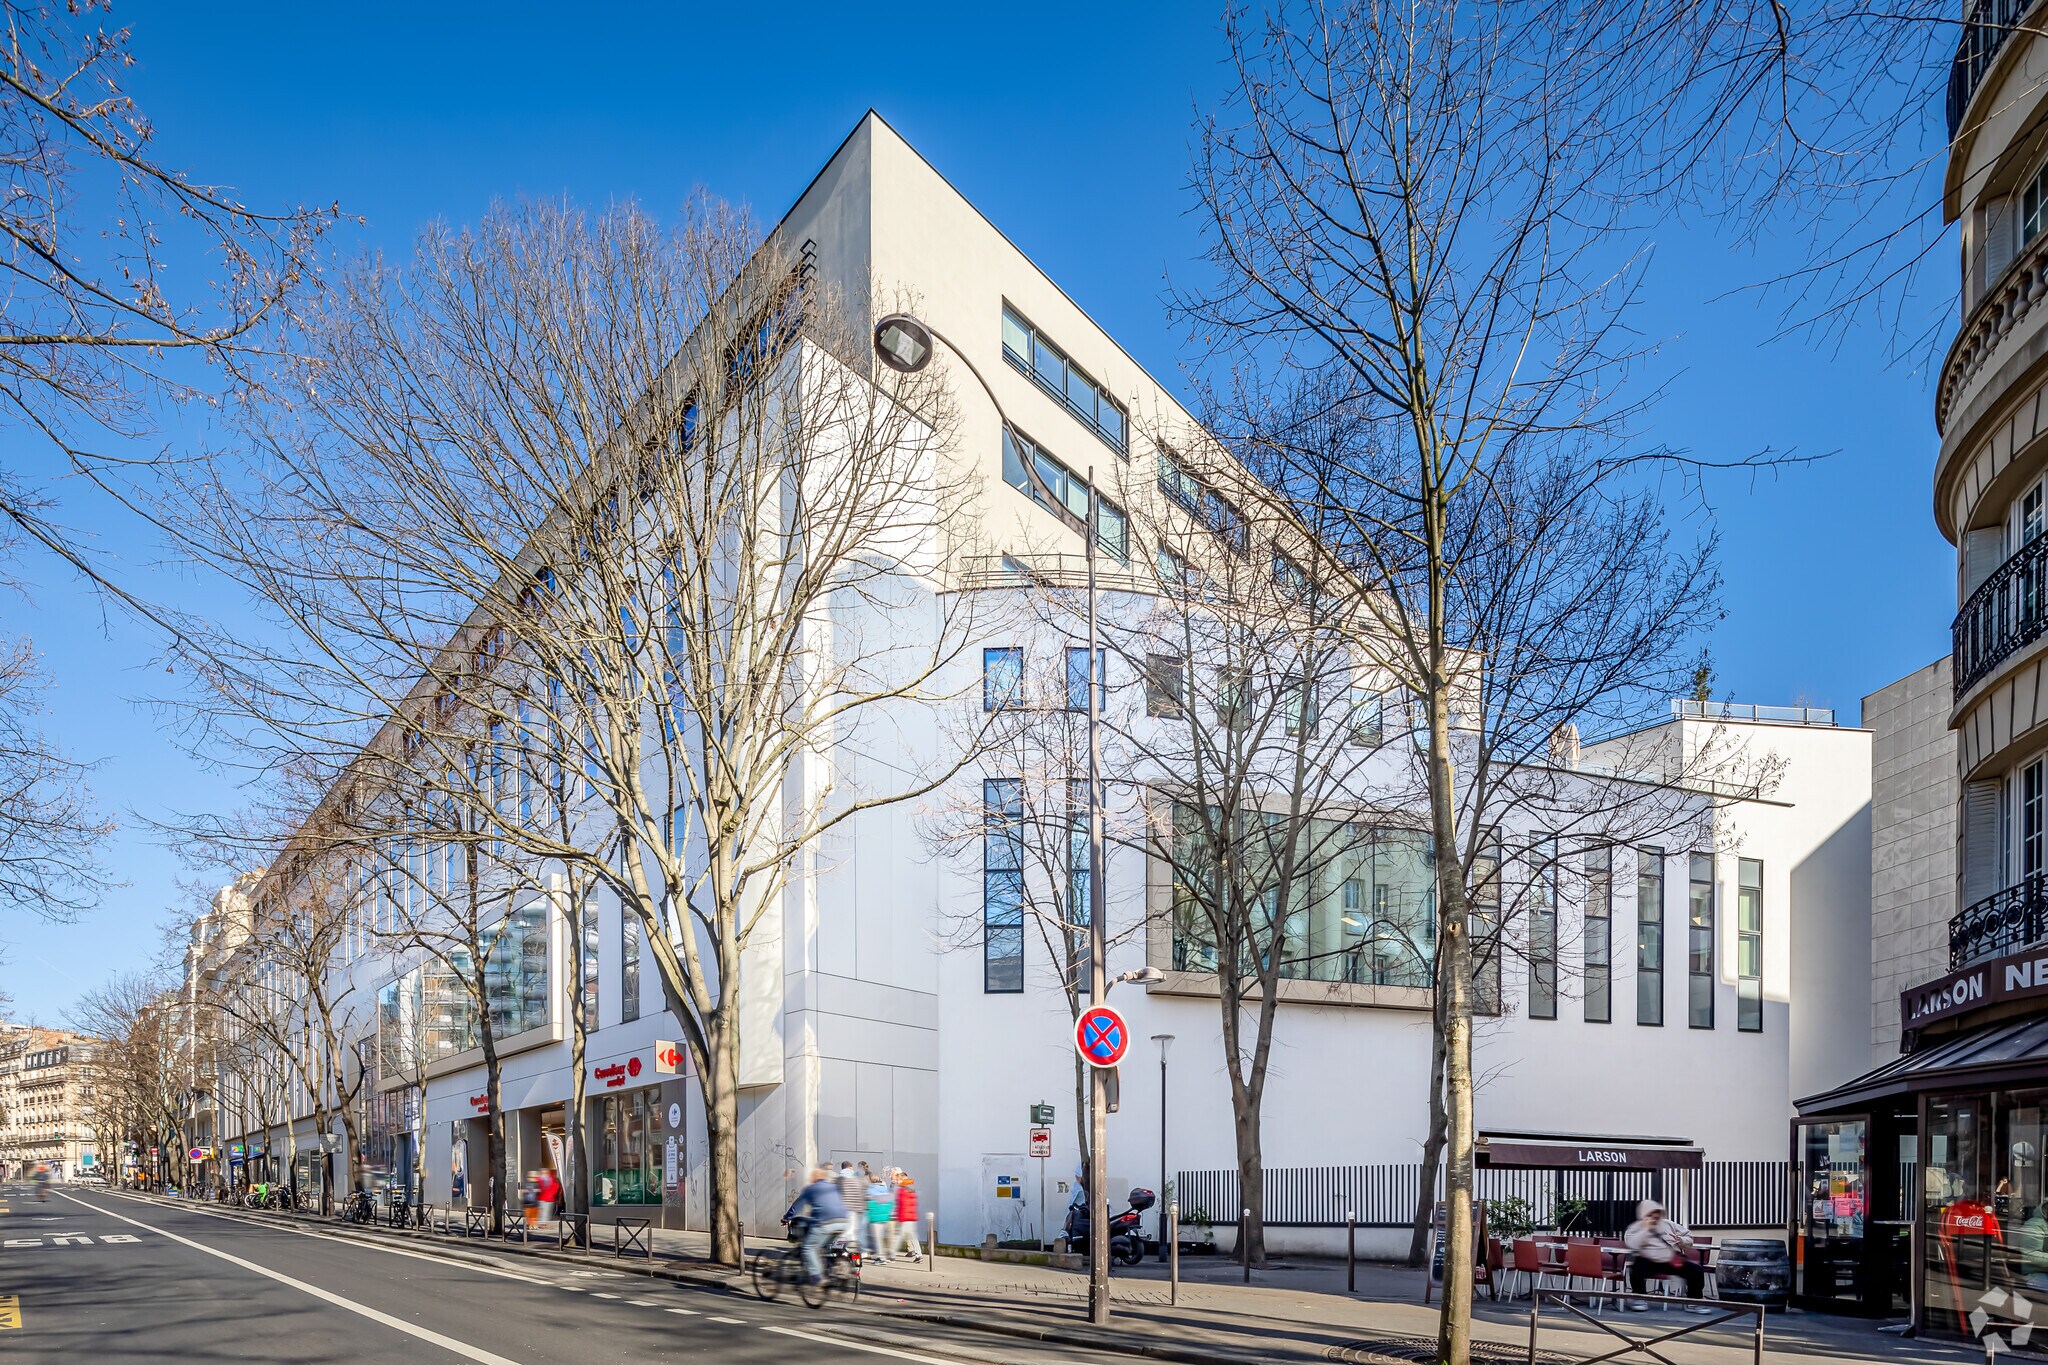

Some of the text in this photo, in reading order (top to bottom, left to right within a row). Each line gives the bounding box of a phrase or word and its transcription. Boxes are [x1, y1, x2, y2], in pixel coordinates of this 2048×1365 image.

[1907, 972, 1983, 1020] LARSON
[1578, 1150, 1627, 1163] LARSON
[3, 1234, 143, 1248] BUS
